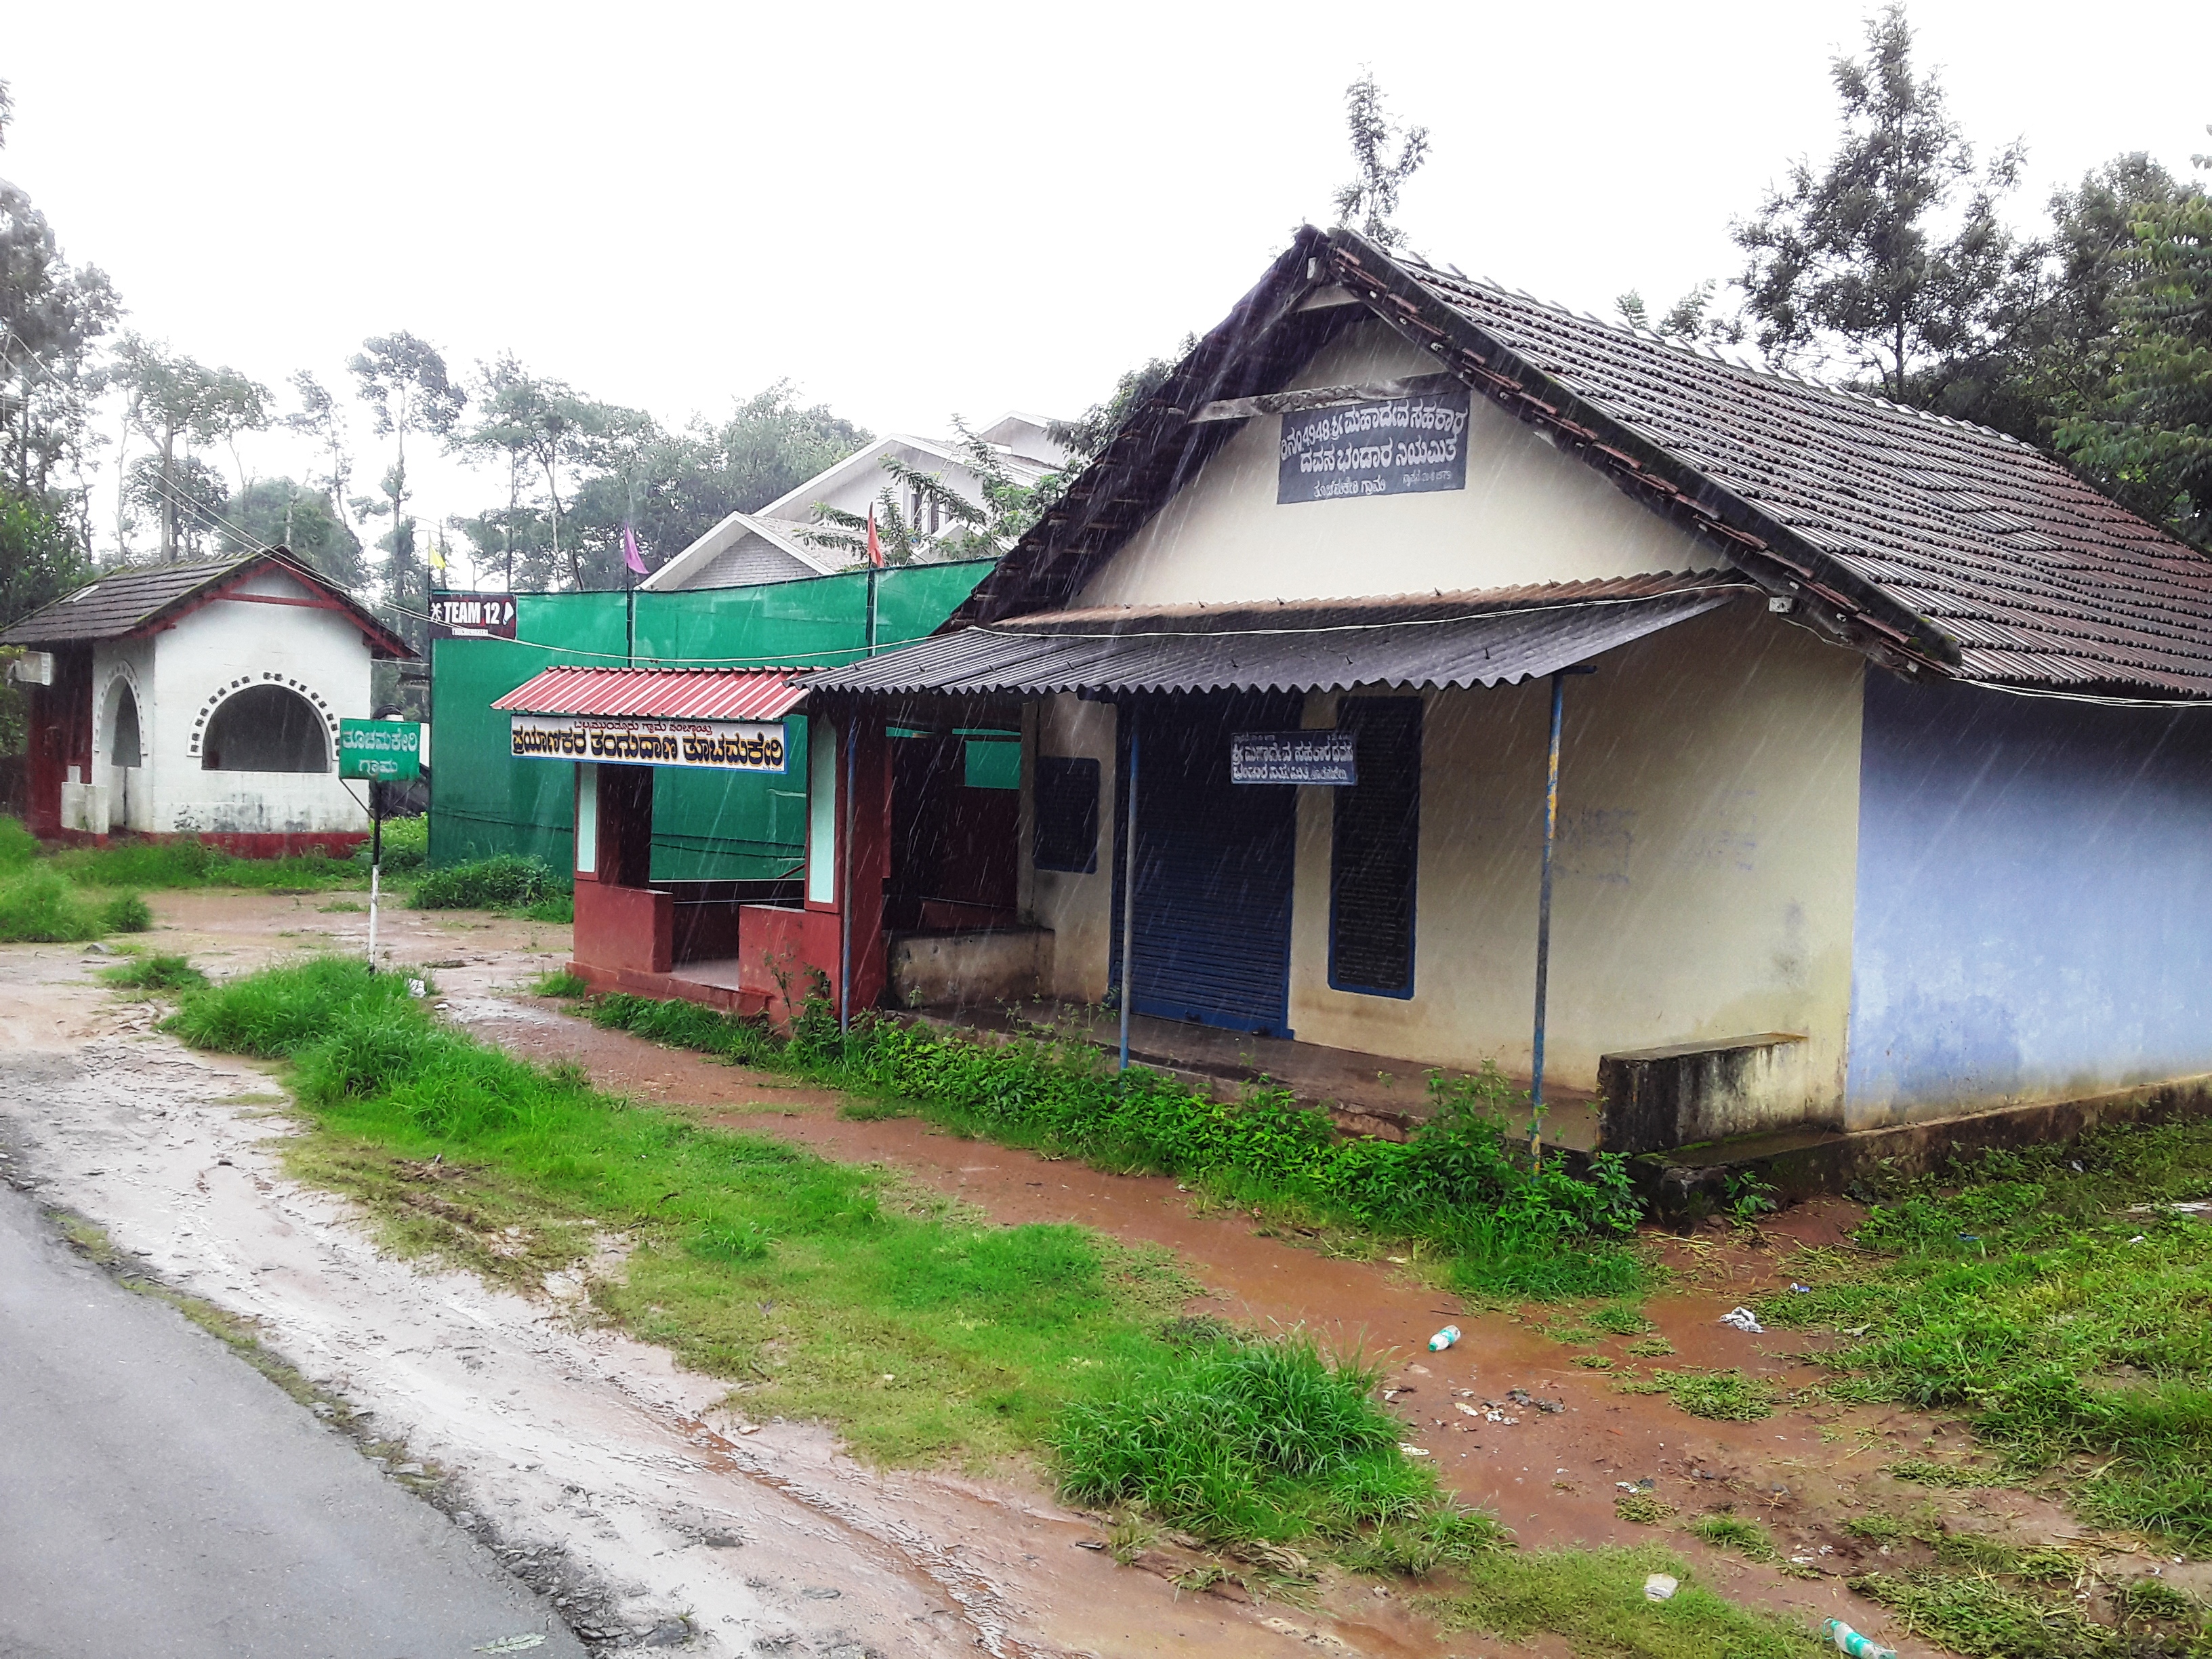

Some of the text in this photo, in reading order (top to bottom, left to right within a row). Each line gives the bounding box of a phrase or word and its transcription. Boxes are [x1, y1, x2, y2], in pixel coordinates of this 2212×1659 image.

[1344, 400, 1410, 434] ಮಹಾದೇವ
[1410, 398, 1469, 435] ಸಹಕಾರ
[1336, 437, 1393, 472] ಭಂಡಾರ
[1395, 434, 1457, 466] ನಿಯಮಿತ
[1361, 474, 1386, 495] ಗ್ರಾಮ
[444, 601, 501, 624] TEAM 12
[642, 720, 667, 733] ಗ್ರಾಮ
[590, 729, 678, 762] ತಂಗುದಾಣ
[682, 731, 783, 767] ತೂಚಮಕೇರಿ
[359, 759, 398, 776] ಗ್ರಾಮ
